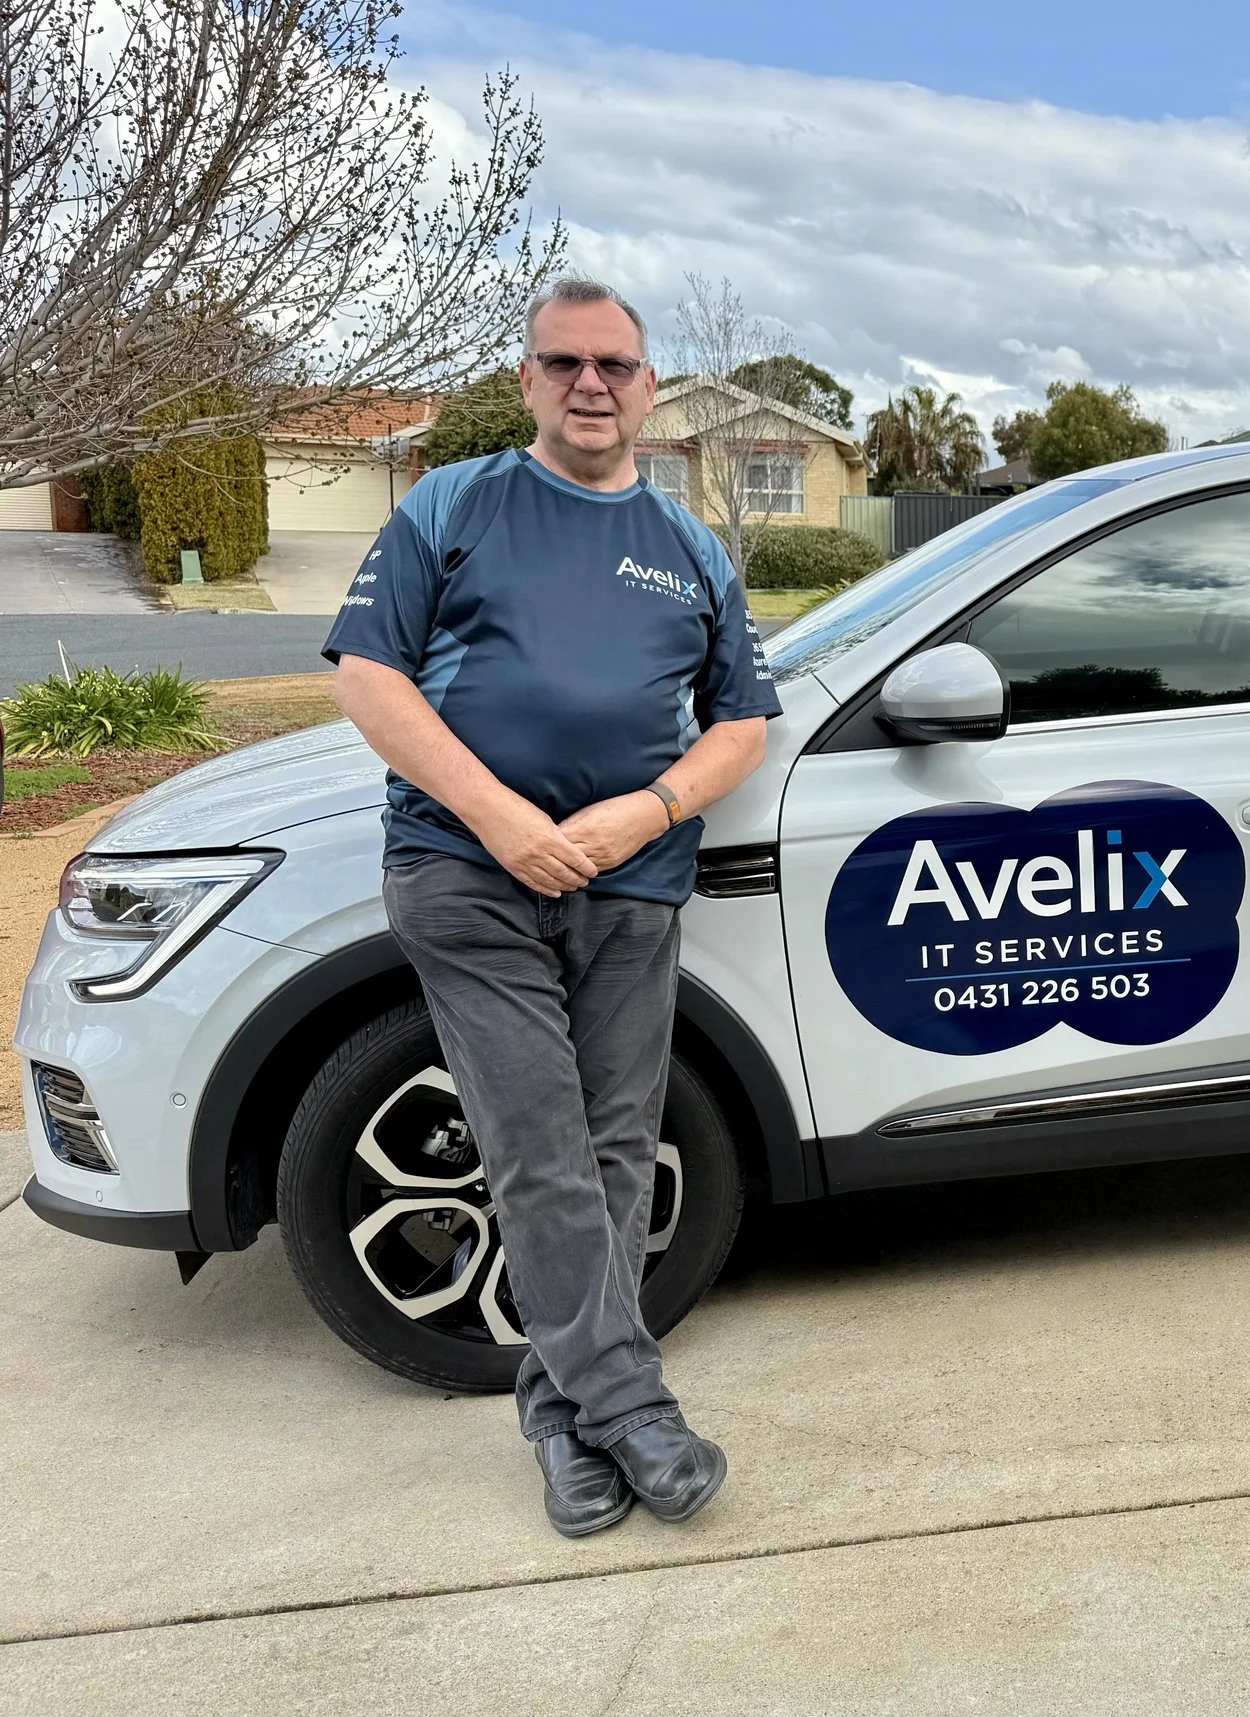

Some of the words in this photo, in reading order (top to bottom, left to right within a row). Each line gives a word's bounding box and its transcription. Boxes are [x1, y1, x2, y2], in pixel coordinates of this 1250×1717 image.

[369, 550, 382, 560] HP
[354, 573, 377, 585] Apple
[616, 556, 698, 599] Avelix
[625, 580, 637, 588] IT
[641, 583, 692, 605] SERVICES
[887, 829, 1189, 925] Avelix
[921, 943, 955, 968] IT
[975, 929, 1164, 965] SERVICES
[933, 982, 1010, 1012] 0431
[1021, 978, 1079, 1005] 226
[1091, 973, 1150, 1000] 503
